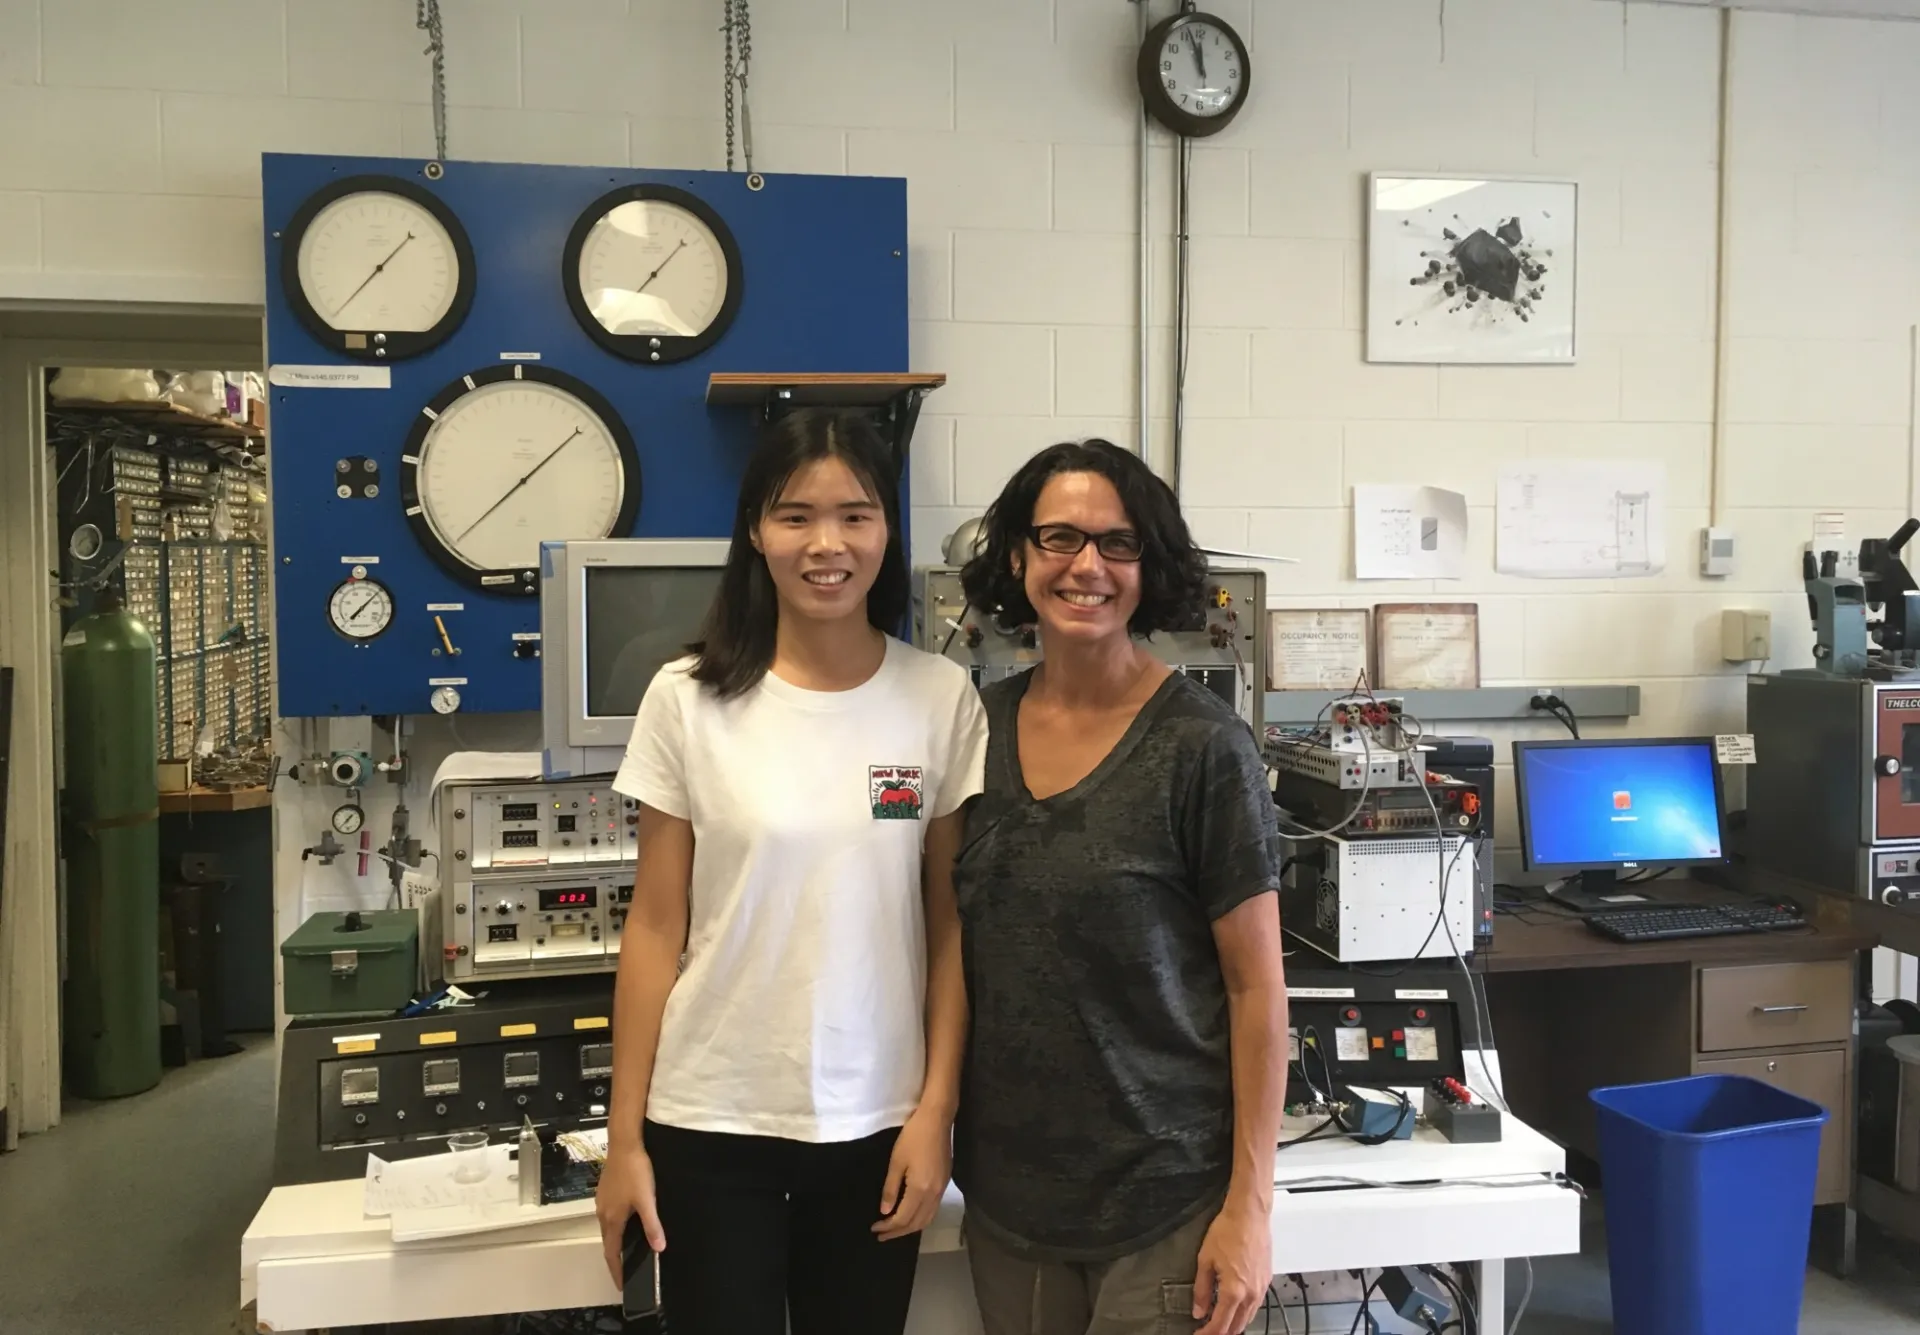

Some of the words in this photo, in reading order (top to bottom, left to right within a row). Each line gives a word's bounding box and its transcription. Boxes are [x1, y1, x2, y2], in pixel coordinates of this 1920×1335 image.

[1195, 29, 1206, 40] 12
[1168, 43, 1179, 54] 10
[1225, 51, 1233, 60] 2
[1164, 61, 1172, 70] 9
[1229, 69, 1237, 78] 3
[1168, 80, 1176, 89] 8
[1224, 86, 1232, 95] 4
[1181, 94, 1189, 104] 7
[1195, 100, 1204, 111] 6
[1280, 632, 1327, 640] OCCUPANCY
[1332, 632, 1359, 640] NOTICE
[872, 769, 893, 778] NEW
[896, 769, 920, 779] YORK
